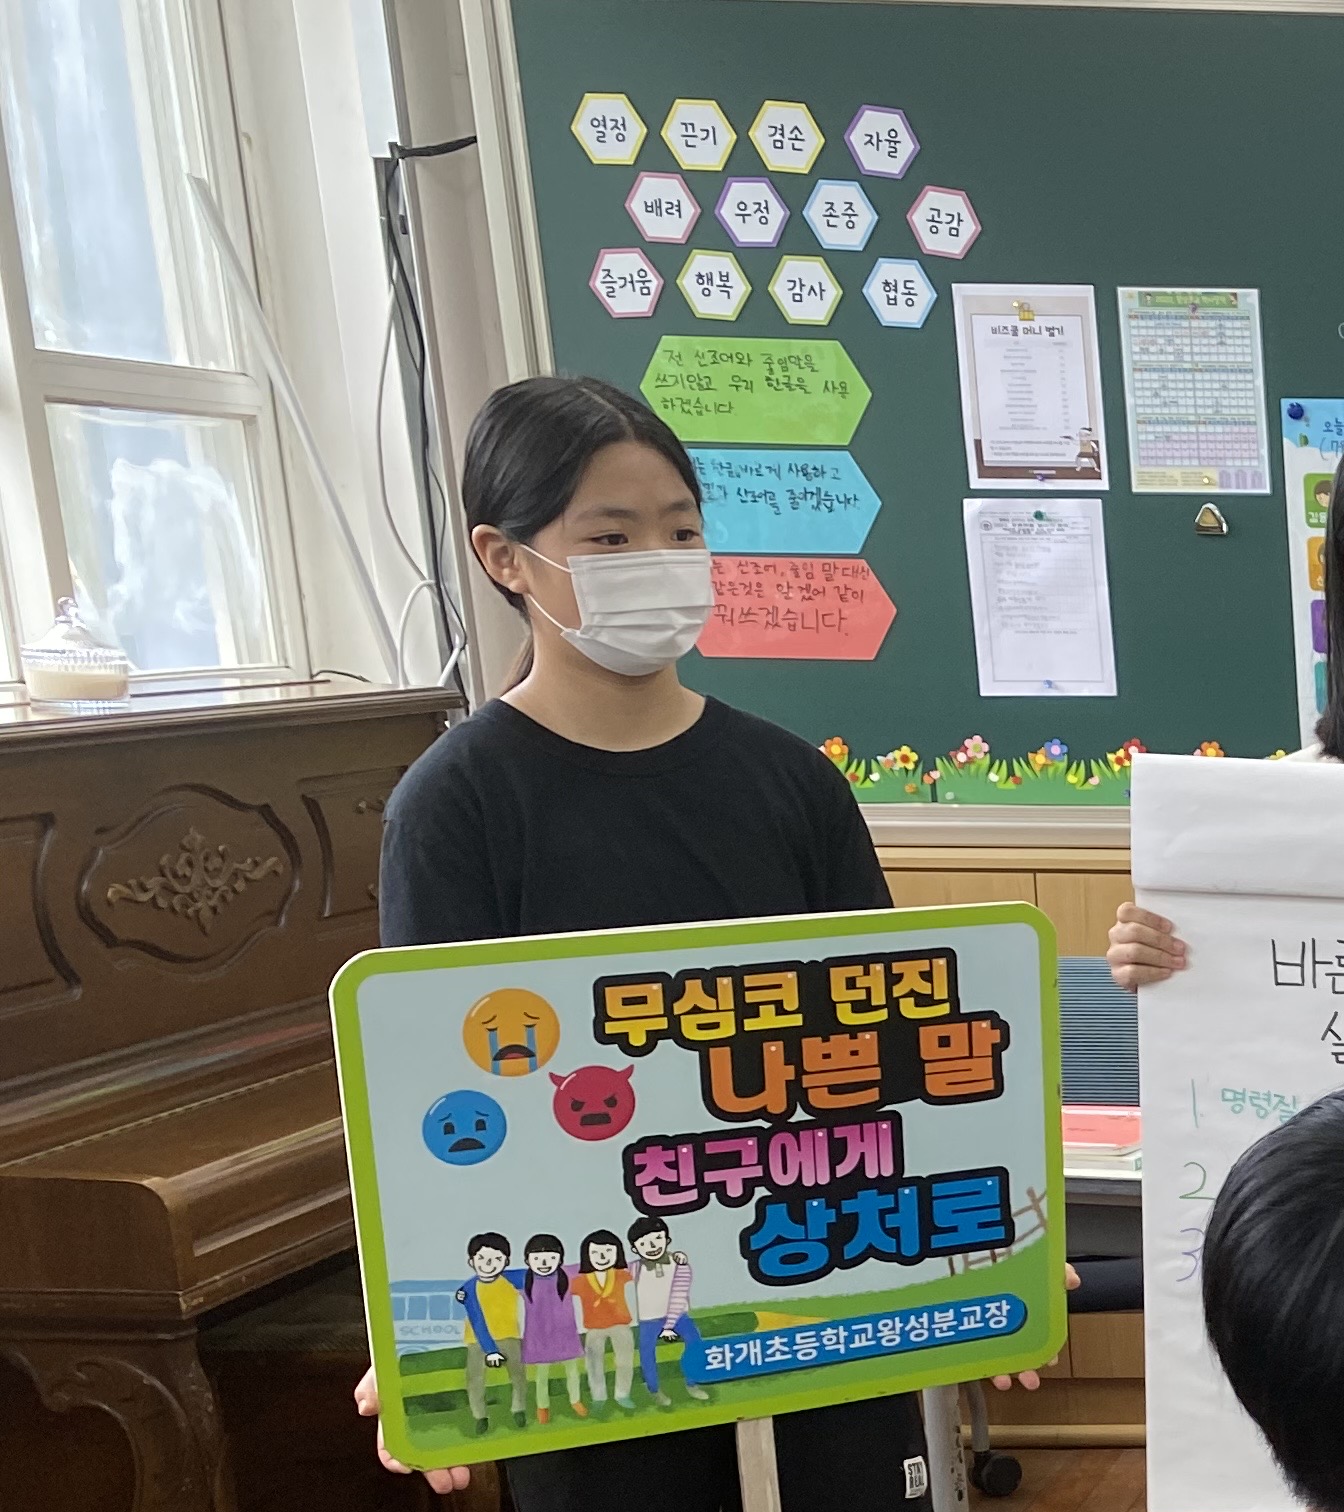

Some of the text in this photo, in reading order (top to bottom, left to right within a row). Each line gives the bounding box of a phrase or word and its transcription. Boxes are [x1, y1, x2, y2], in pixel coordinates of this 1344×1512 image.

[590, 115, 627, 144] 열정
[680, 121, 717, 148] 끈기
[768, 123, 806, 151] 겸손
[863, 128, 901, 159] 자율
[644, 198, 682, 219] 배려
[734, 199, 770, 225] 우정
[822, 201, 858, 229] 존중
[925, 207, 964, 238] 공감
[600, 267, 653, 298] 즐거움
[695, 270, 734, 299] 행복
[787, 278, 826, 303] 감사
[881, 278, 918, 308] 협동
[1022, 326, 1042, 335] 머니
[1045, 325, 1064, 337] 벌기
[729, 374, 754, 394] 우리
[764, 375, 812, 395] 한글을
[602, 957, 953, 1048] 무심코 던진
[709, 1019, 1002, 1115] 나쁜 말
[632, 1120, 896, 1209] 친구에게
[749, 1175, 1007, 1279] 상처로
[399, 1324, 462, 1336] SCHOOL
